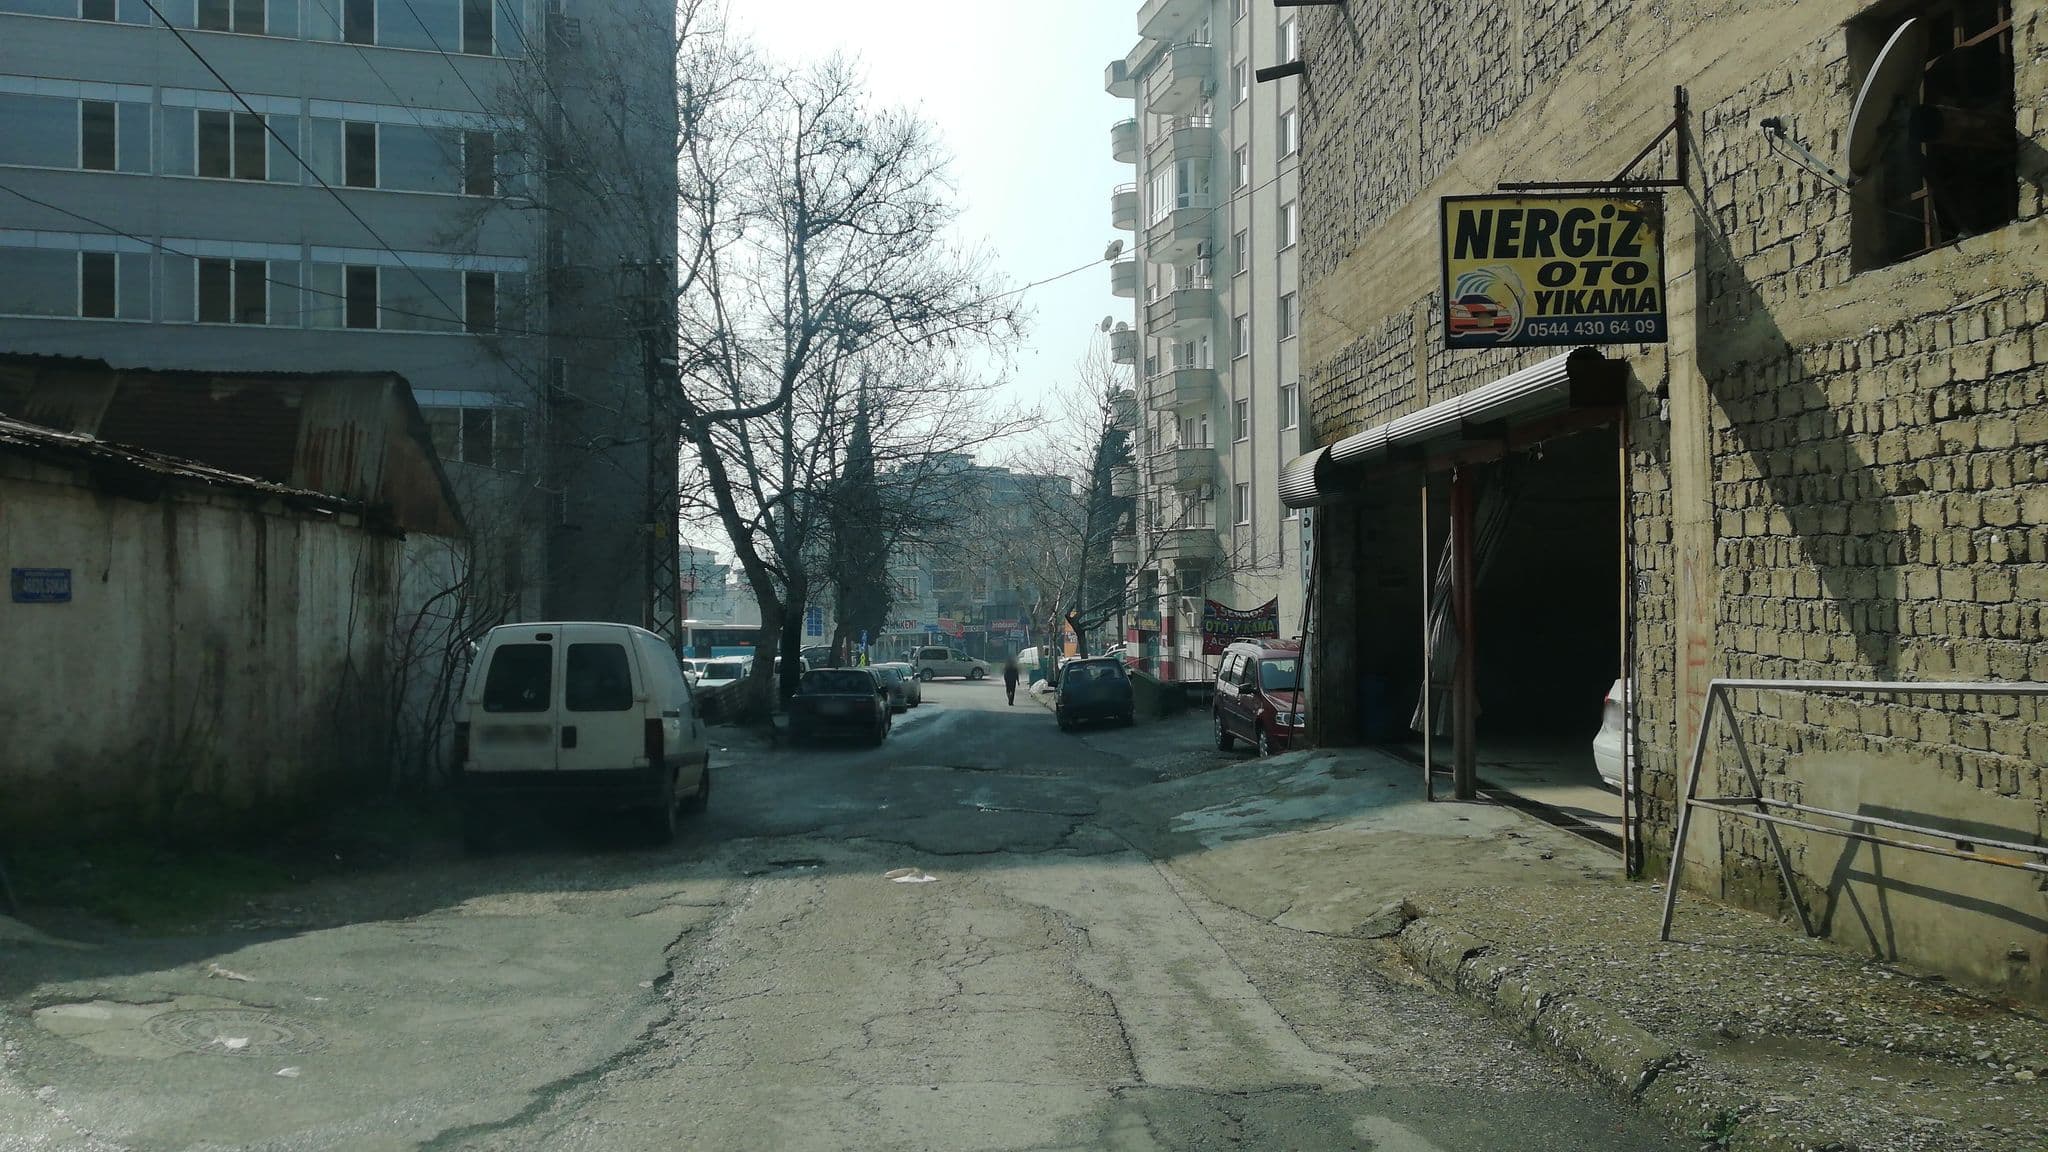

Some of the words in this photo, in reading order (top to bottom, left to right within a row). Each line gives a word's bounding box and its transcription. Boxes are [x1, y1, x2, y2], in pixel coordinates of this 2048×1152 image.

[1537, 260, 1649, 287] OTO
[1534, 287, 1658, 315] YIKAMA
[1528, 321, 1569, 337] 0544
[1574, 320, 1605, 336] 430
[1610, 319, 1630, 334] 64
[1635, 319, 1655, 334] 09
[1205, 620, 1229, 634] OTO
